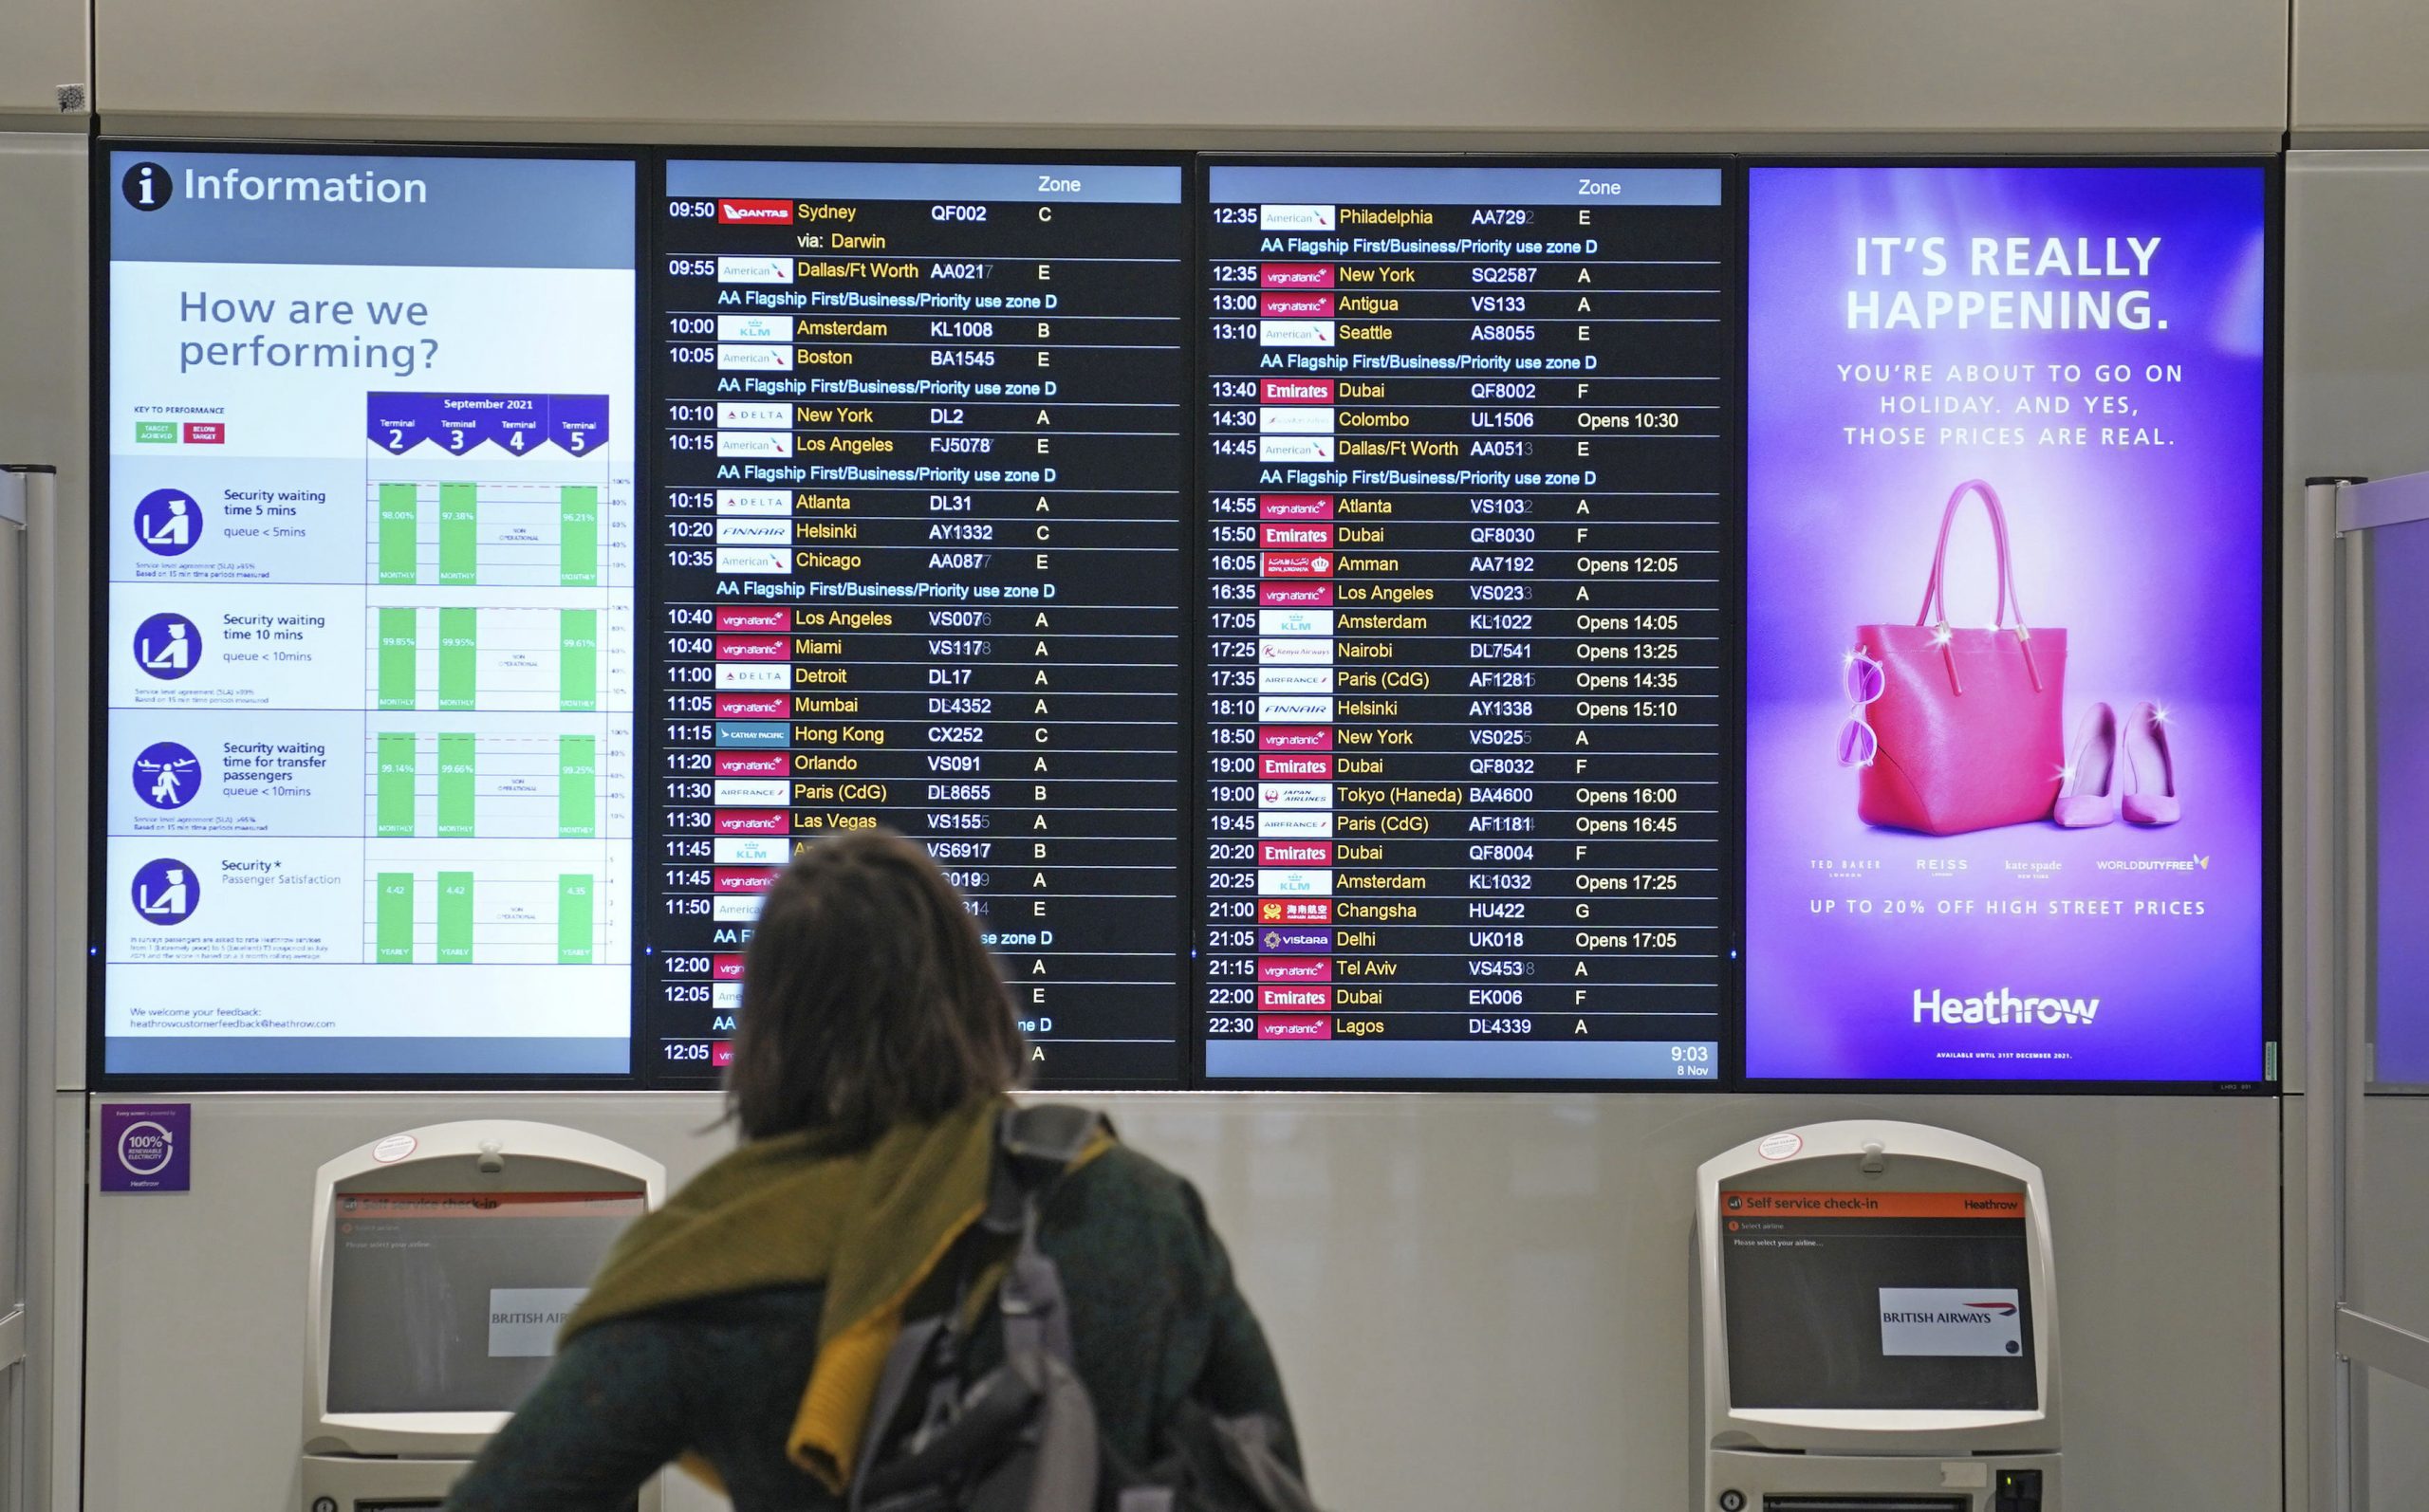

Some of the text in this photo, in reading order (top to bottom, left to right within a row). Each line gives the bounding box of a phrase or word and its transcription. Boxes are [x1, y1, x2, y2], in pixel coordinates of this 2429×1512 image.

[186, 168, 426, 203] Information
[1038, 175, 1081, 192] Zone
[1579, 179, 1621, 194] Zone
[669, 202, 1051, 222] 09:50 QANTAS Sydney QF002 C
[797, 232, 885, 249] via: Darwin
[1857, 237, 2161, 276] IT'S REALLY
[1214, 266, 1591, 283] 12:35 New York SQ2587 A
[718, 290, 1057, 310] AA Flagship First/Business/Priority use zone D
[181, 291, 428, 326] How are we
[1848, 290, 2168, 330] HAPPENING.
[670, 319, 714, 334] 10:00
[797, 320, 887, 336] Amsterdam
[931, 322, 993, 337] KL1008
[1038, 323, 1049, 338] B
[181, 335, 438, 377] performing?
[1838, 365, 2182, 382] YOU'RE ABOUT TO GO ON
[444, 399, 533, 411] September 2021
[1882, 396, 2139, 416] HOLIDAY. AND YES,
[670, 405, 1050, 425] 10:10 DELTA New York DL2 A
[562, 421, 596, 430] Terminal
[390, 429, 403, 449] 2
[451, 430, 463, 449] 3
[510, 432, 525, 450] 4
[570, 432, 585, 451] 5
[1845, 428, 2176, 445] THOSE PRICES ARE REAL.
[224, 489, 325, 504] Security waiting
[224, 505, 296, 516] time 5 mins
[563, 513, 594, 522] 96.21%
[668, 725, 712, 740] 11:15
[795, 726, 837, 744] Hong
[843, 727, 884, 745] Kong
[928, 727, 983, 742] CX252
[1035, 728, 1048, 743] C
[224, 742, 324, 756] Security waiting
[223, 755, 326, 767] time for transfer
[224, 770, 292, 784] passengers
[1212, 786, 1254, 802] 19:00
[1337, 787, 1385, 804] Tokyo
[1390, 787, 1462, 805] (Haneda)
[1470, 787, 1533, 802] BA4600
[1576, 788, 1628, 805] Opens
[1633, 788, 1677, 802] 16:00
[1810, 860, 1880, 870] TED BAKER
[1917, 859, 1967, 870] REISS
[2006, 860, 2062, 872] kate spade
[2096, 860, 2194, 870] WORLDDUTYFREE
[222, 874, 341, 886] Passenger Satisfaction
[1210, 902, 1589, 920] 21:00 Changsha HU422 G
[1287, 905, 1327, 914] 海南航空
[1810, 900, 2205, 915] UP TO 20% OFF HIGH STREET PRICES
[1210, 931, 1254, 946] 21:05
[1337, 931, 1376, 946] Delhi
[1470, 931, 1524, 947] UK018
[1576, 932, 1627, 950] Opens
[1633, 932, 1677, 948] 17:05
[130, 1007, 146, 1016] We
[193, 1010, 213, 1019] your
[216, 1007, 261, 1016] feedback:
[1914, 987, 2100, 1024] Heathrow
[130, 1019, 336, 1028] heathrowcustomerfeedback@heathrow.com
[1671, 1046, 1708, 1061] 9:03
[1678, 1065, 1709, 1076] 8 Nov
[129, 1136, 163, 1148] 100%
[1746, 1197, 1879, 1209] Self service check-in
[1964, 1199, 2018, 1209] Heathrow
[492, 1313, 543, 1323] BRITISH
[1883, 1313, 1991, 1323] BRITISH AIRWAYS
